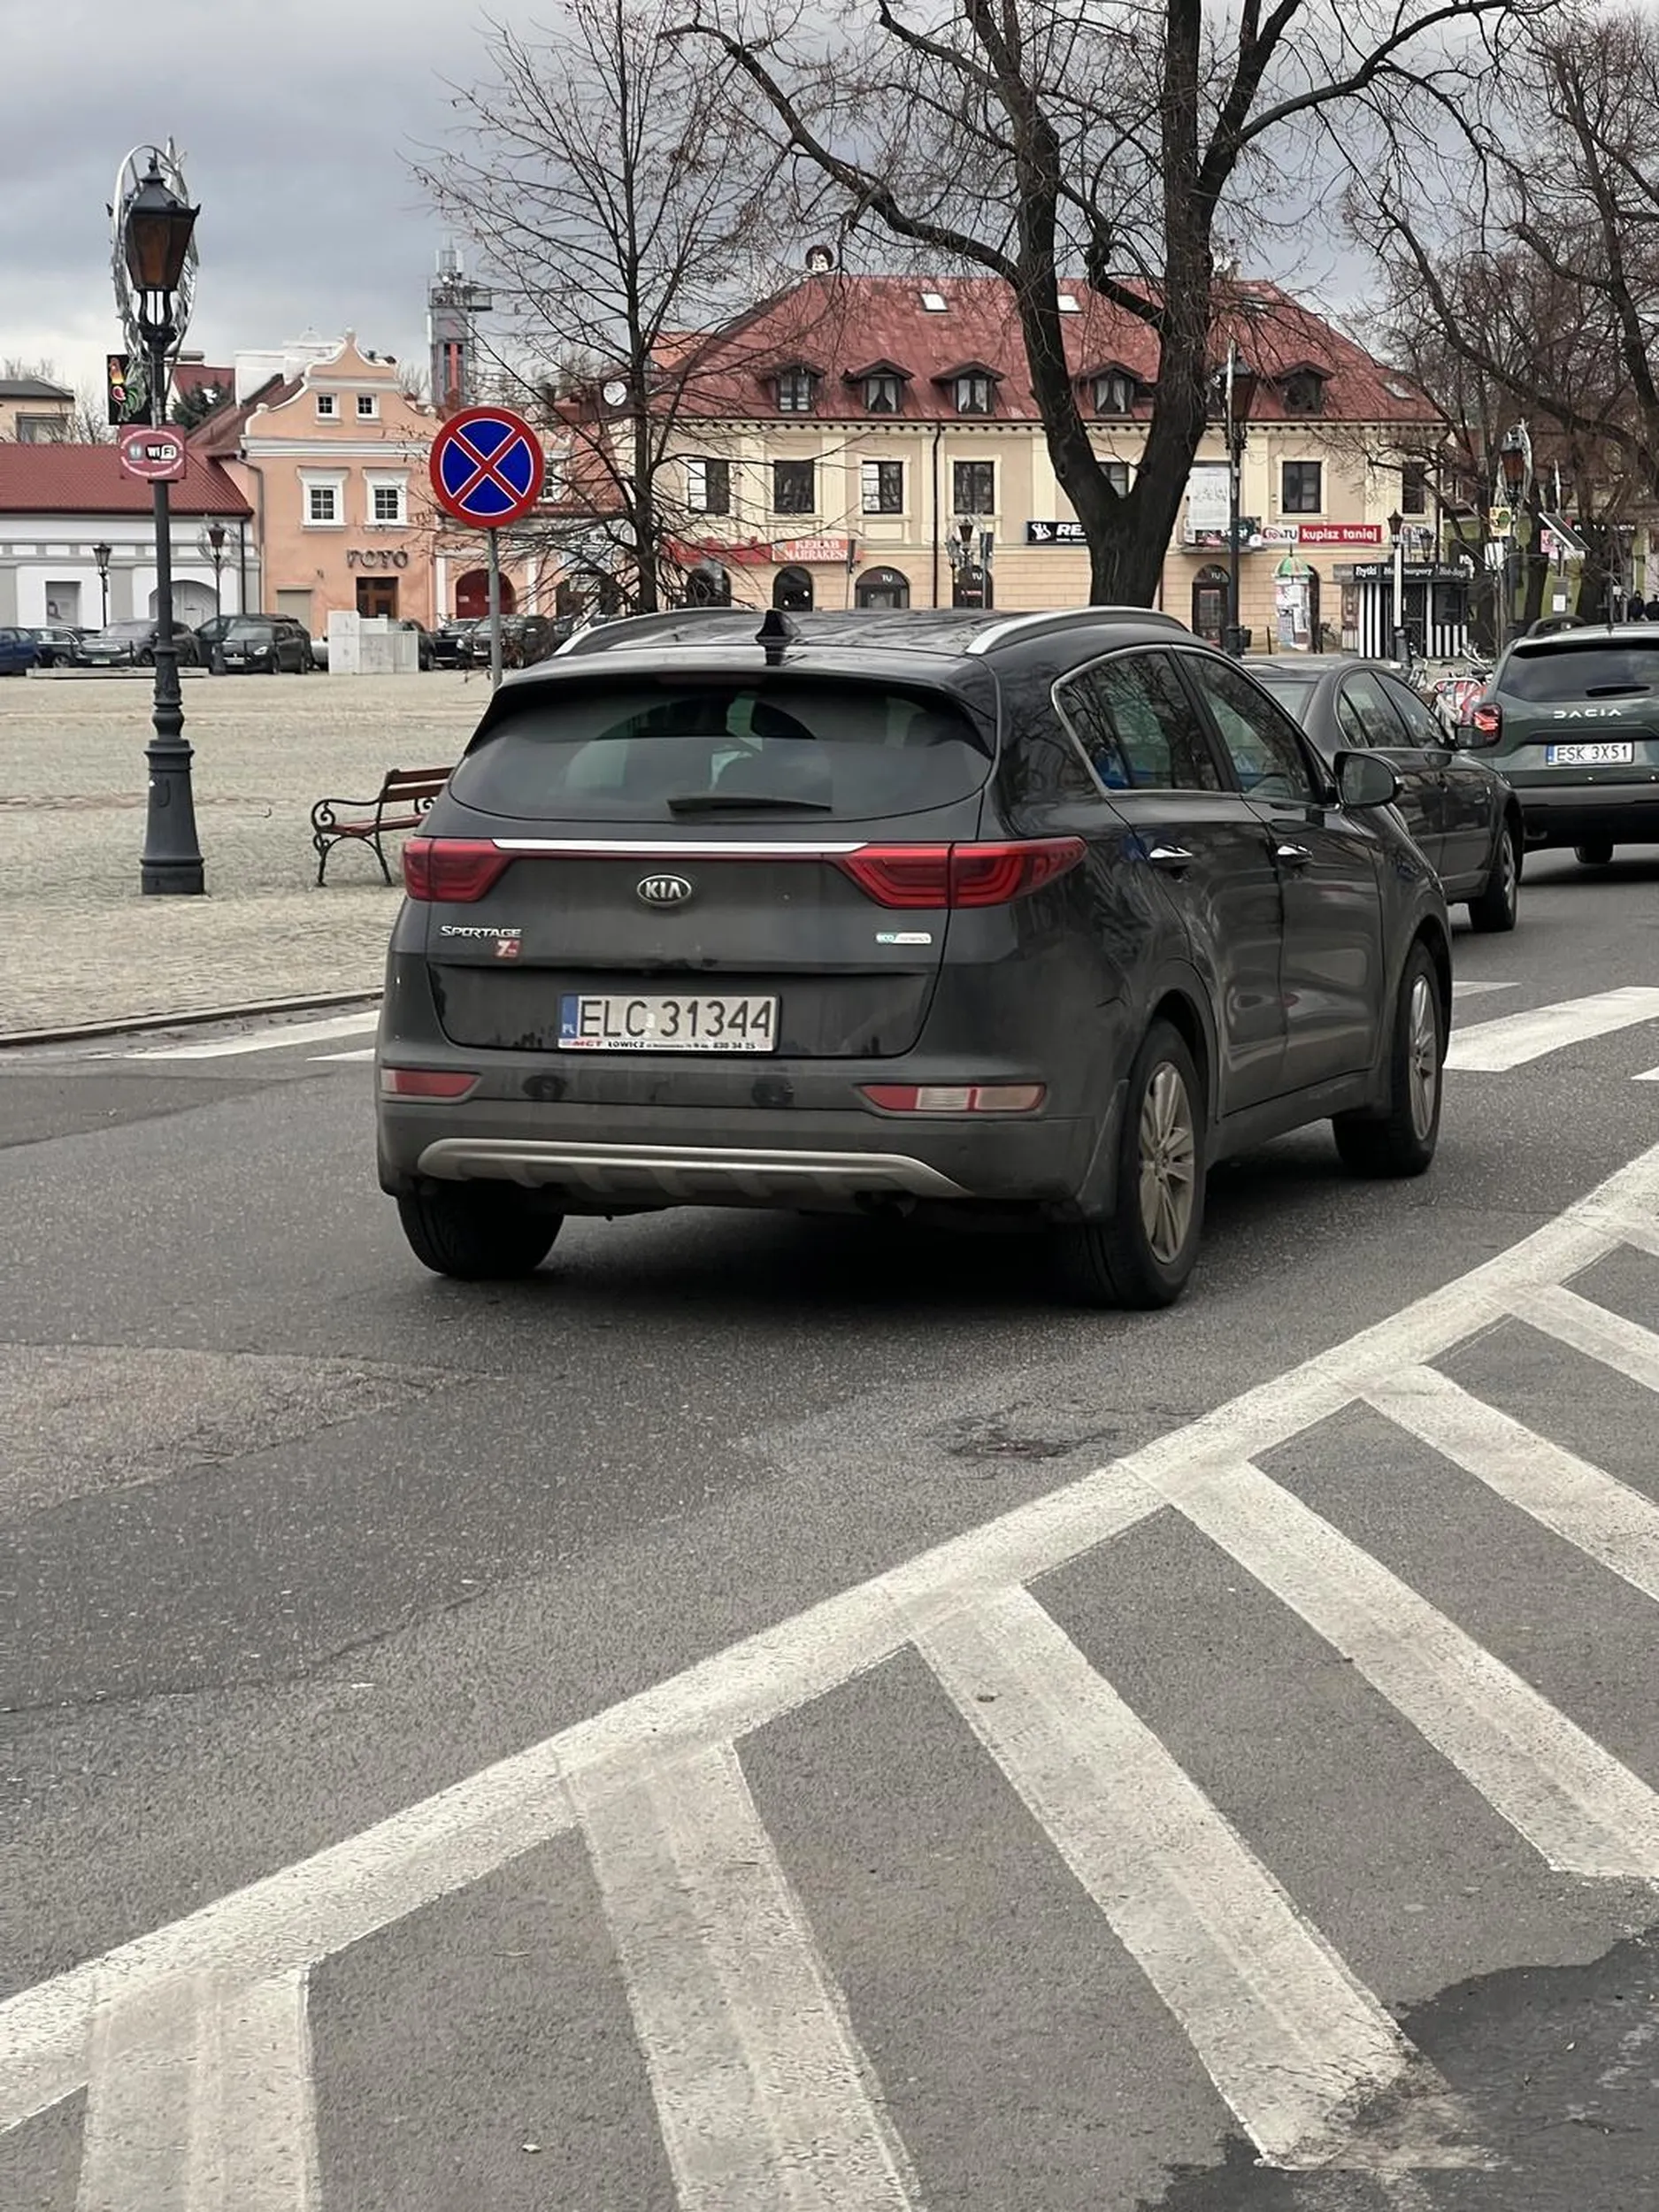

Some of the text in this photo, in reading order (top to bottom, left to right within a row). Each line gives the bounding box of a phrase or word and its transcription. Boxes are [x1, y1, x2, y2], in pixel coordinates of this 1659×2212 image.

[1302, 527, 1378, 542] kupisz taniej
[795, 540, 840, 549] KEBAB
[1553, 709, 1622, 719] DACIA
[1557, 744, 1628, 761] ESK 3X51
[646, 881, 681, 898] KIA
[441, 925, 522, 939] SPORTAGE
[580, 1000, 772, 1037] ELC 31344
